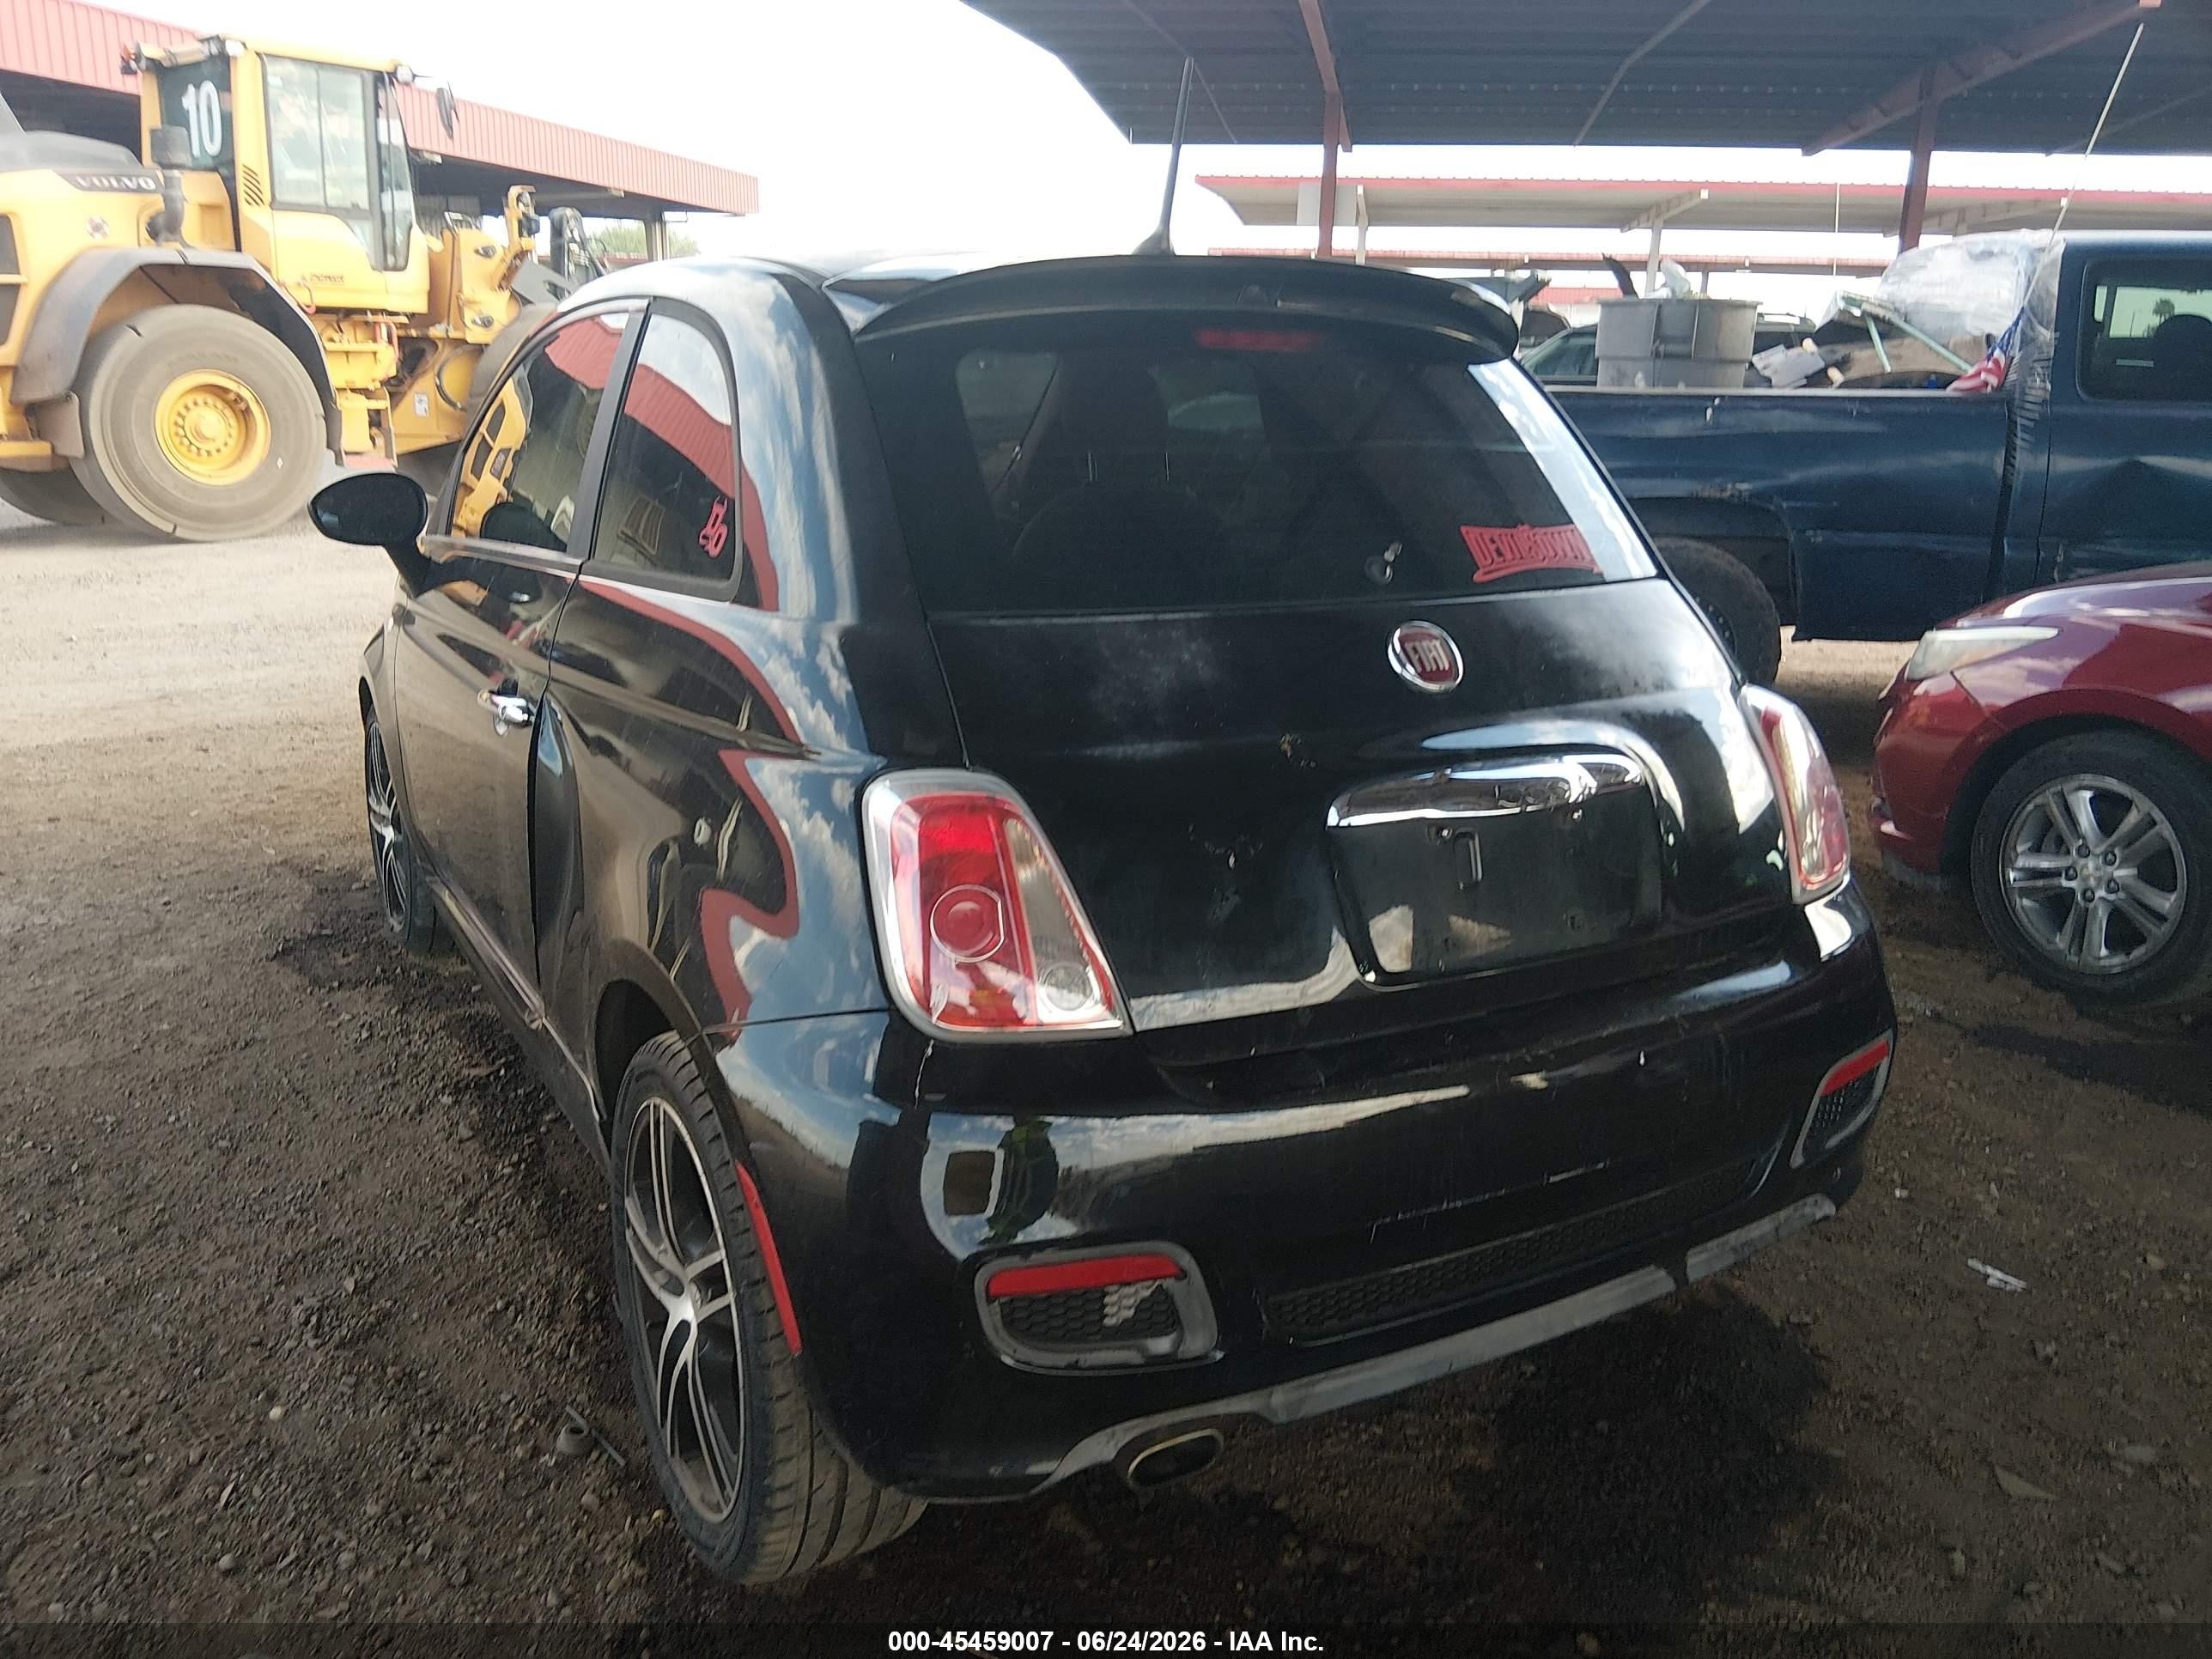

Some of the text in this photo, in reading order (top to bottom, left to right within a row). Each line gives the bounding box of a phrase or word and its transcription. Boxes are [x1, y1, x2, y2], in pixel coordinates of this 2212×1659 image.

[181, 80, 222, 159] 10
[75, 175, 156, 190] VOLVO
[1404, 638, 1450, 673] FIAT
